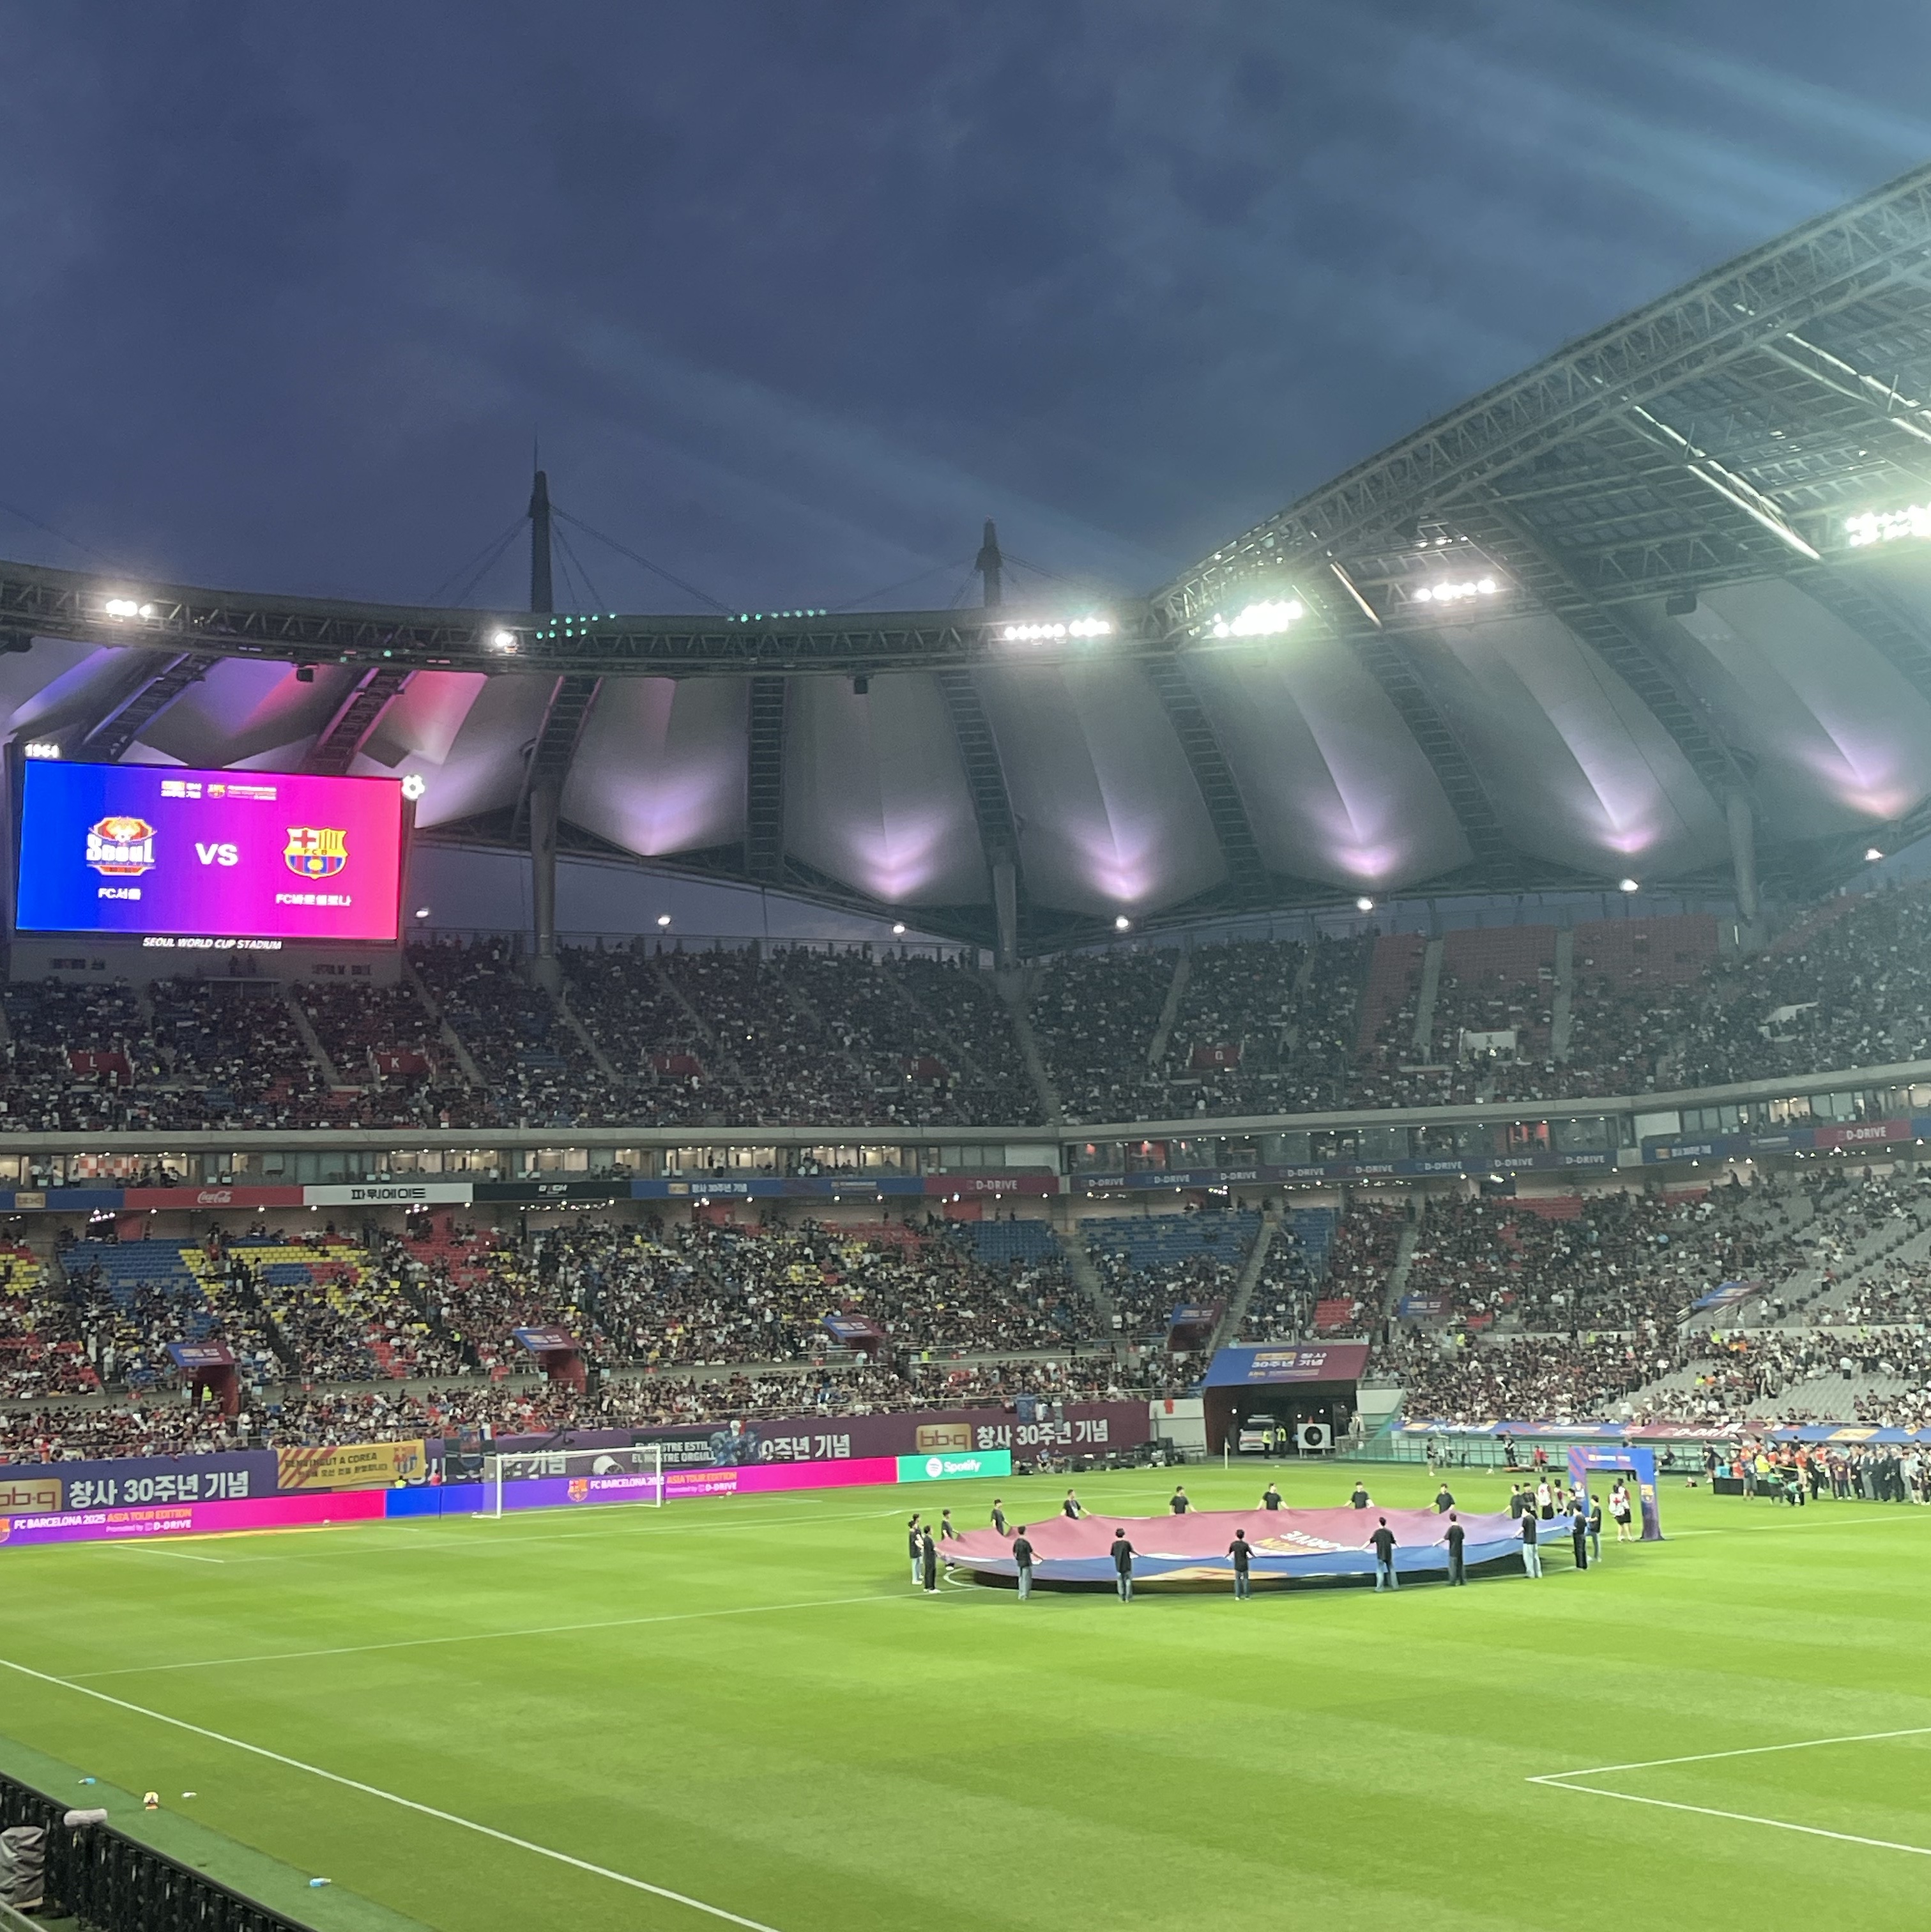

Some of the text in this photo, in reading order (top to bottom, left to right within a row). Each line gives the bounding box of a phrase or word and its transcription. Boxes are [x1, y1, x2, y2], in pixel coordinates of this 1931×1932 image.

[195, 842, 238, 866] VS
[142, 937, 282, 949] SEOUL WORLD CUP STADIUM
[976, 1179, 1017, 1190] D-DRIVE
[351, 1188, 426, 1200] 파워에이드
[977, 1419, 1109, 1449] 창사 30주년 기념
[814, 1434, 850, 1458] 기념
[348, 1452, 377, 1464] COREA
[944, 1459, 982, 1474] Spotify
[590, 1480, 600, 1489] FC
[601, 1476, 647, 1489] BARCELONA
[69, 1480, 118, 1509] 창사
[123, 1475, 199, 1503] 30주년
[204, 1471, 249, 1498] 기념
[14, 1508, 192, 1530] FC BARCELONA 2025 ASIA TOUR EDITION
[153, 1519, 192, 1531] D-DRIVE
